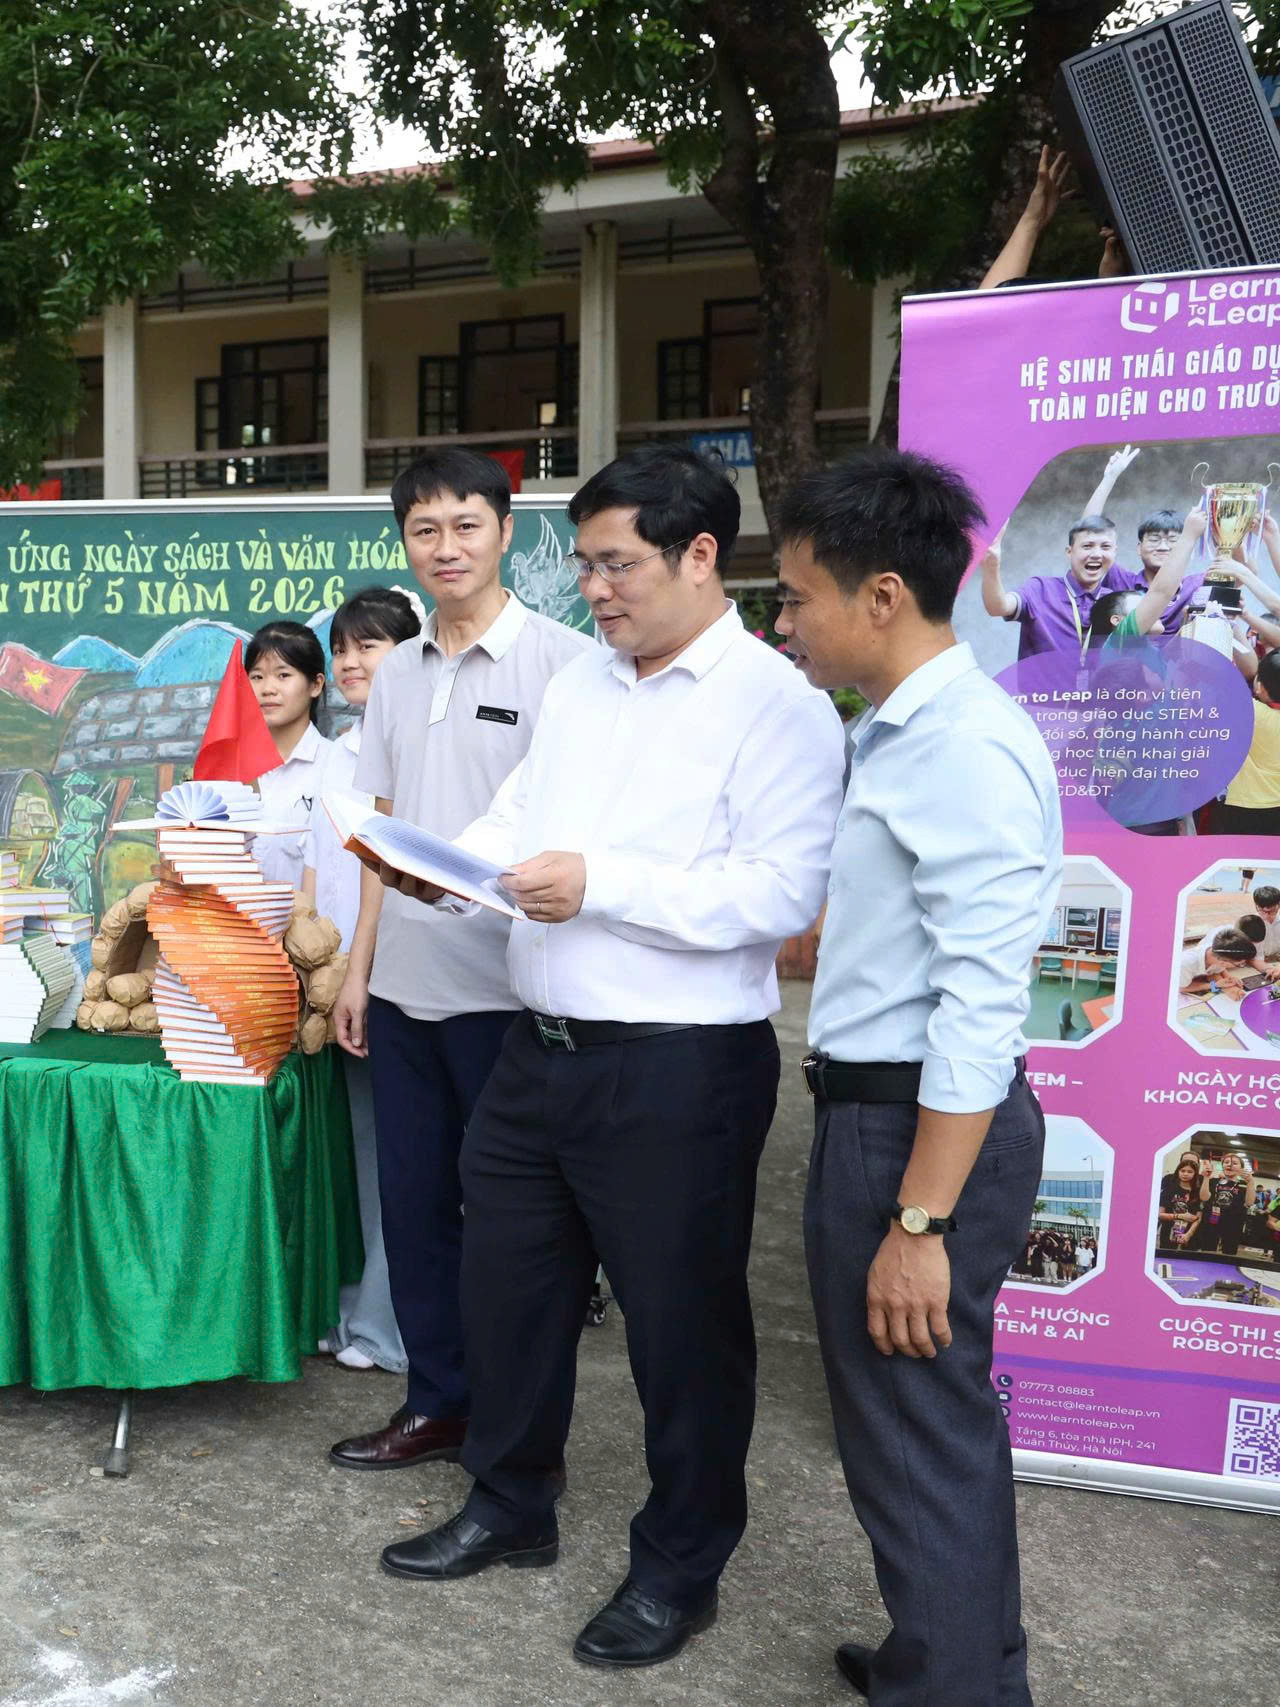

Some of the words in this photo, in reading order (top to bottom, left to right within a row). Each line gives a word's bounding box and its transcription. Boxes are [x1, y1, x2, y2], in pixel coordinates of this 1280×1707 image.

[1188, 277, 1280, 303] Learn
[1188, 304, 1206, 316] To
[1207, 302, 1280, 328] Leap
[1021, 356, 1049, 391] HỆ
[1058, 357, 1112, 385] SINH
[1122, 347, 1175, 380] THÁI
[1185, 342, 1242, 376] GIÁO
[1029, 391, 1086, 423] TOÀN
[1096, 386, 1148, 421] DIỆN
[1158, 387, 1207, 414] CHO
[8, 529, 71, 574] ỨNG
[84, 530, 158, 573] NGÀY
[163, 531, 231, 573] SÁCH
[236, 528, 274, 571] VÀ
[278, 534, 336, 572] VĂN
[348, 526, 409, 571] HÓA
[19, 572, 91, 615] THỨ
[104, 576, 125, 615] 5
[138, 571, 230, 615] NĂM
[248, 575, 345, 614] 2026
[1032, 692, 1049, 704] to
[1053, 690, 1092, 703] Leap
[1097, 688, 1110, 700] là
[1115, 688, 1147, 701] đơn
[1152, 688, 1165, 703] vị
[1170, 687, 1202, 701] tiên
[1036, 710, 1078, 723] trong
[1083, 708, 1118, 722] giáo
[1122, 707, 1154, 723] dục
[1158, 707, 1204, 720] STEM
[1209, 707, 1220, 719] &
[1093, 726, 1137, 742] đồng
[1141, 727, 1184, 740] hành
[1188, 726, 1231, 741] cùng
[1065, 746, 1094, 761] học
[1099, 745, 1137, 760] triển
[1142, 746, 1177, 760] khai
[1181, 745, 1210, 762] giải
[1057, 765, 1087, 780] dục
[1092, 765, 1128, 781] hiện
[1132, 765, 1158, 781] đại
[1162, 767, 1200, 779] theo
[1178, 1069, 1242, 1087] NGÀY
[1144, 1089, 1209, 1105] KHOA
[1216, 1091, 1268, 1110] HỌC
[1031, 1305, 1110, 1327] HƯỚNG
[1043, 1325, 1059, 1338] &
[1063, 1327, 1085, 1341] AI
[1159, 1317, 1224, 1337] CUỘC
[1229, 1324, 1267, 1341] THI
[1019, 1380, 1055, 1393] 07773
[1057, 1385, 1096, 1397] 08883
[1018, 1395, 1161, 1418] contact@learntoleap.vn
[1017, 1410, 1135, 1431] www.learntoleap.vn
[1083, 1435, 1106, 1445] nhà
[1109, 1437, 1134, 1448] IPH,
[1136, 1440, 1156, 1450] 241
[1083, 1445, 1099, 1453] Hà
